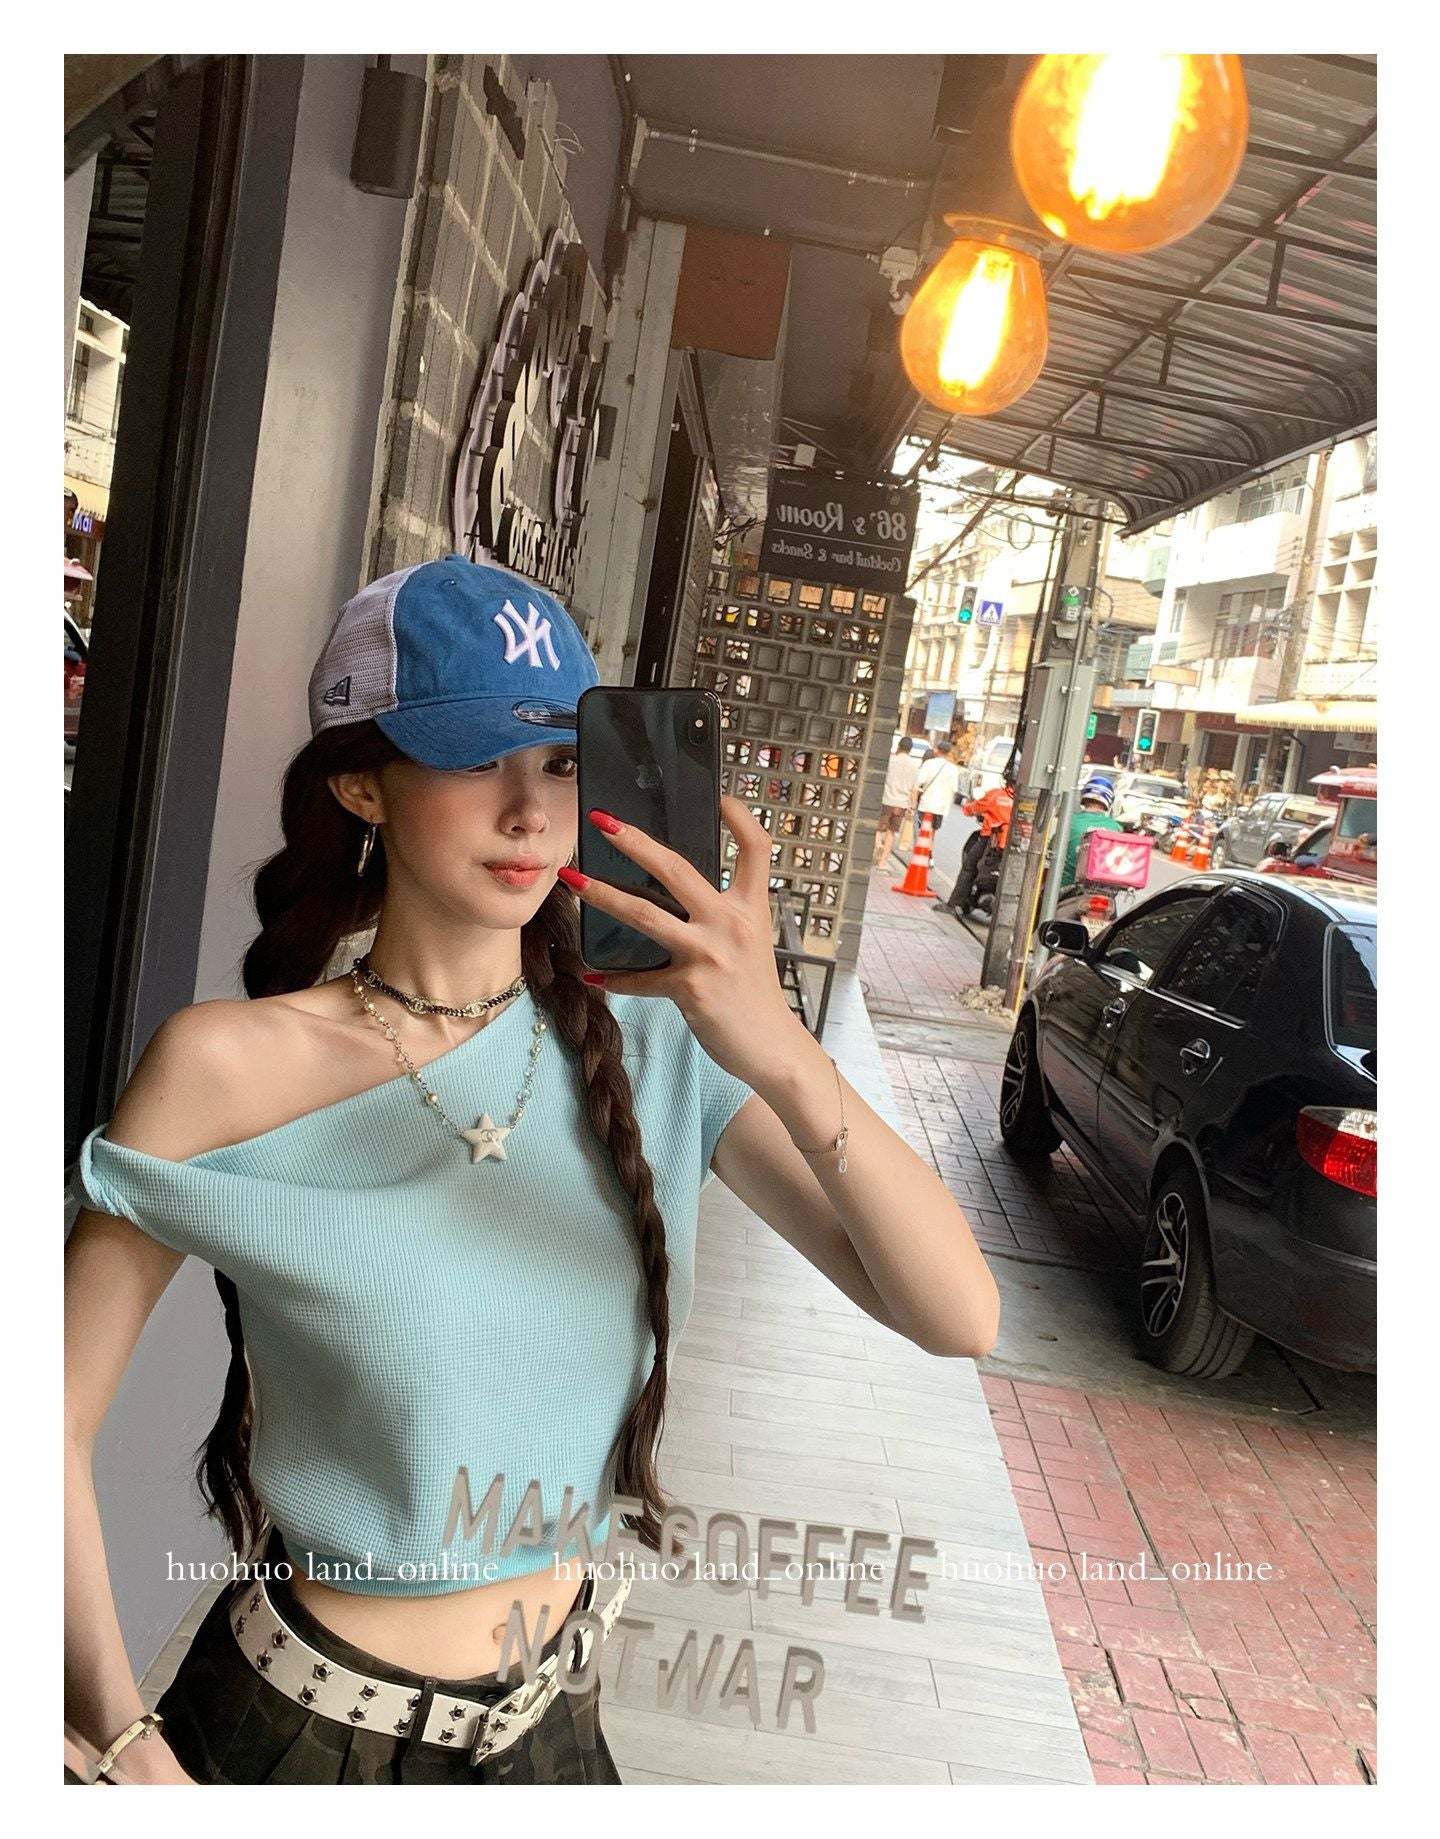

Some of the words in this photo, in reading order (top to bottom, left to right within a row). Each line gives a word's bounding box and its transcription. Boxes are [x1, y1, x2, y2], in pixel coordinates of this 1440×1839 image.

[442, 1466, 645, 1580] MAKE
[660, 1505, 938, 1624] COFFEE
[496, 1600, 655, 1700] NOT
[656, 1629, 826, 1734] WAR
